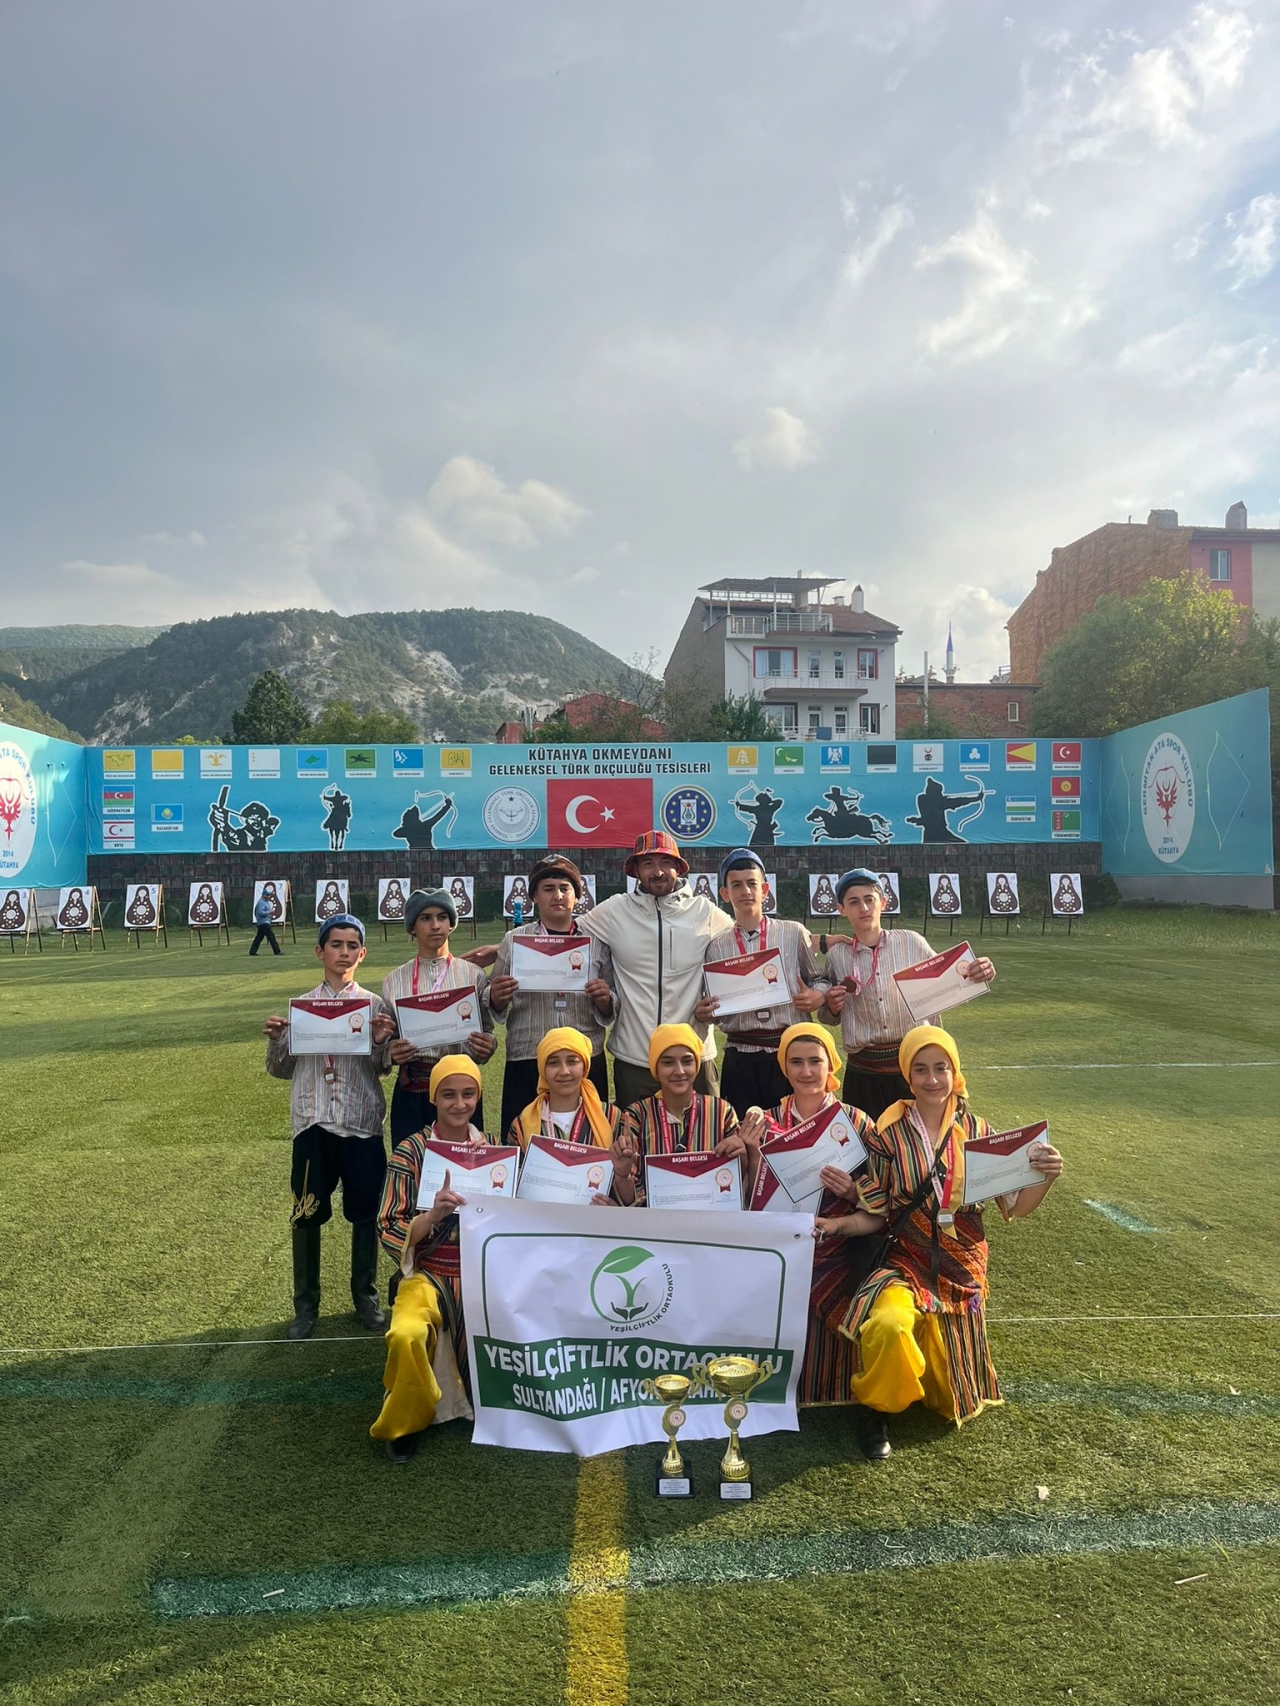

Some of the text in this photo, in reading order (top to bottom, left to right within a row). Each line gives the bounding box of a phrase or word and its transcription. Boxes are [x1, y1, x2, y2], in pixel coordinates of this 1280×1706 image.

[529, 747, 671, 760] KÜTAHYA OKMEYDANI
[1154, 740, 1165, 756] ATA
[1166, 738, 1181, 755] SPOR
[12, 749, 26, 771] SPOR
[490, 762, 711, 776] GELENEKSEL TÜRK OKÇULUĞU TESİSLERİ
[989, 1136, 1005, 1144] BAŞARI
[610, 1263, 674, 1333] YEŞİLÇİFTLİK ORTAOKULU
[484, 1340, 630, 1380] YEŞİLÇİFTLİK
[512, 1377, 597, 1415] SULTANDAĞI
